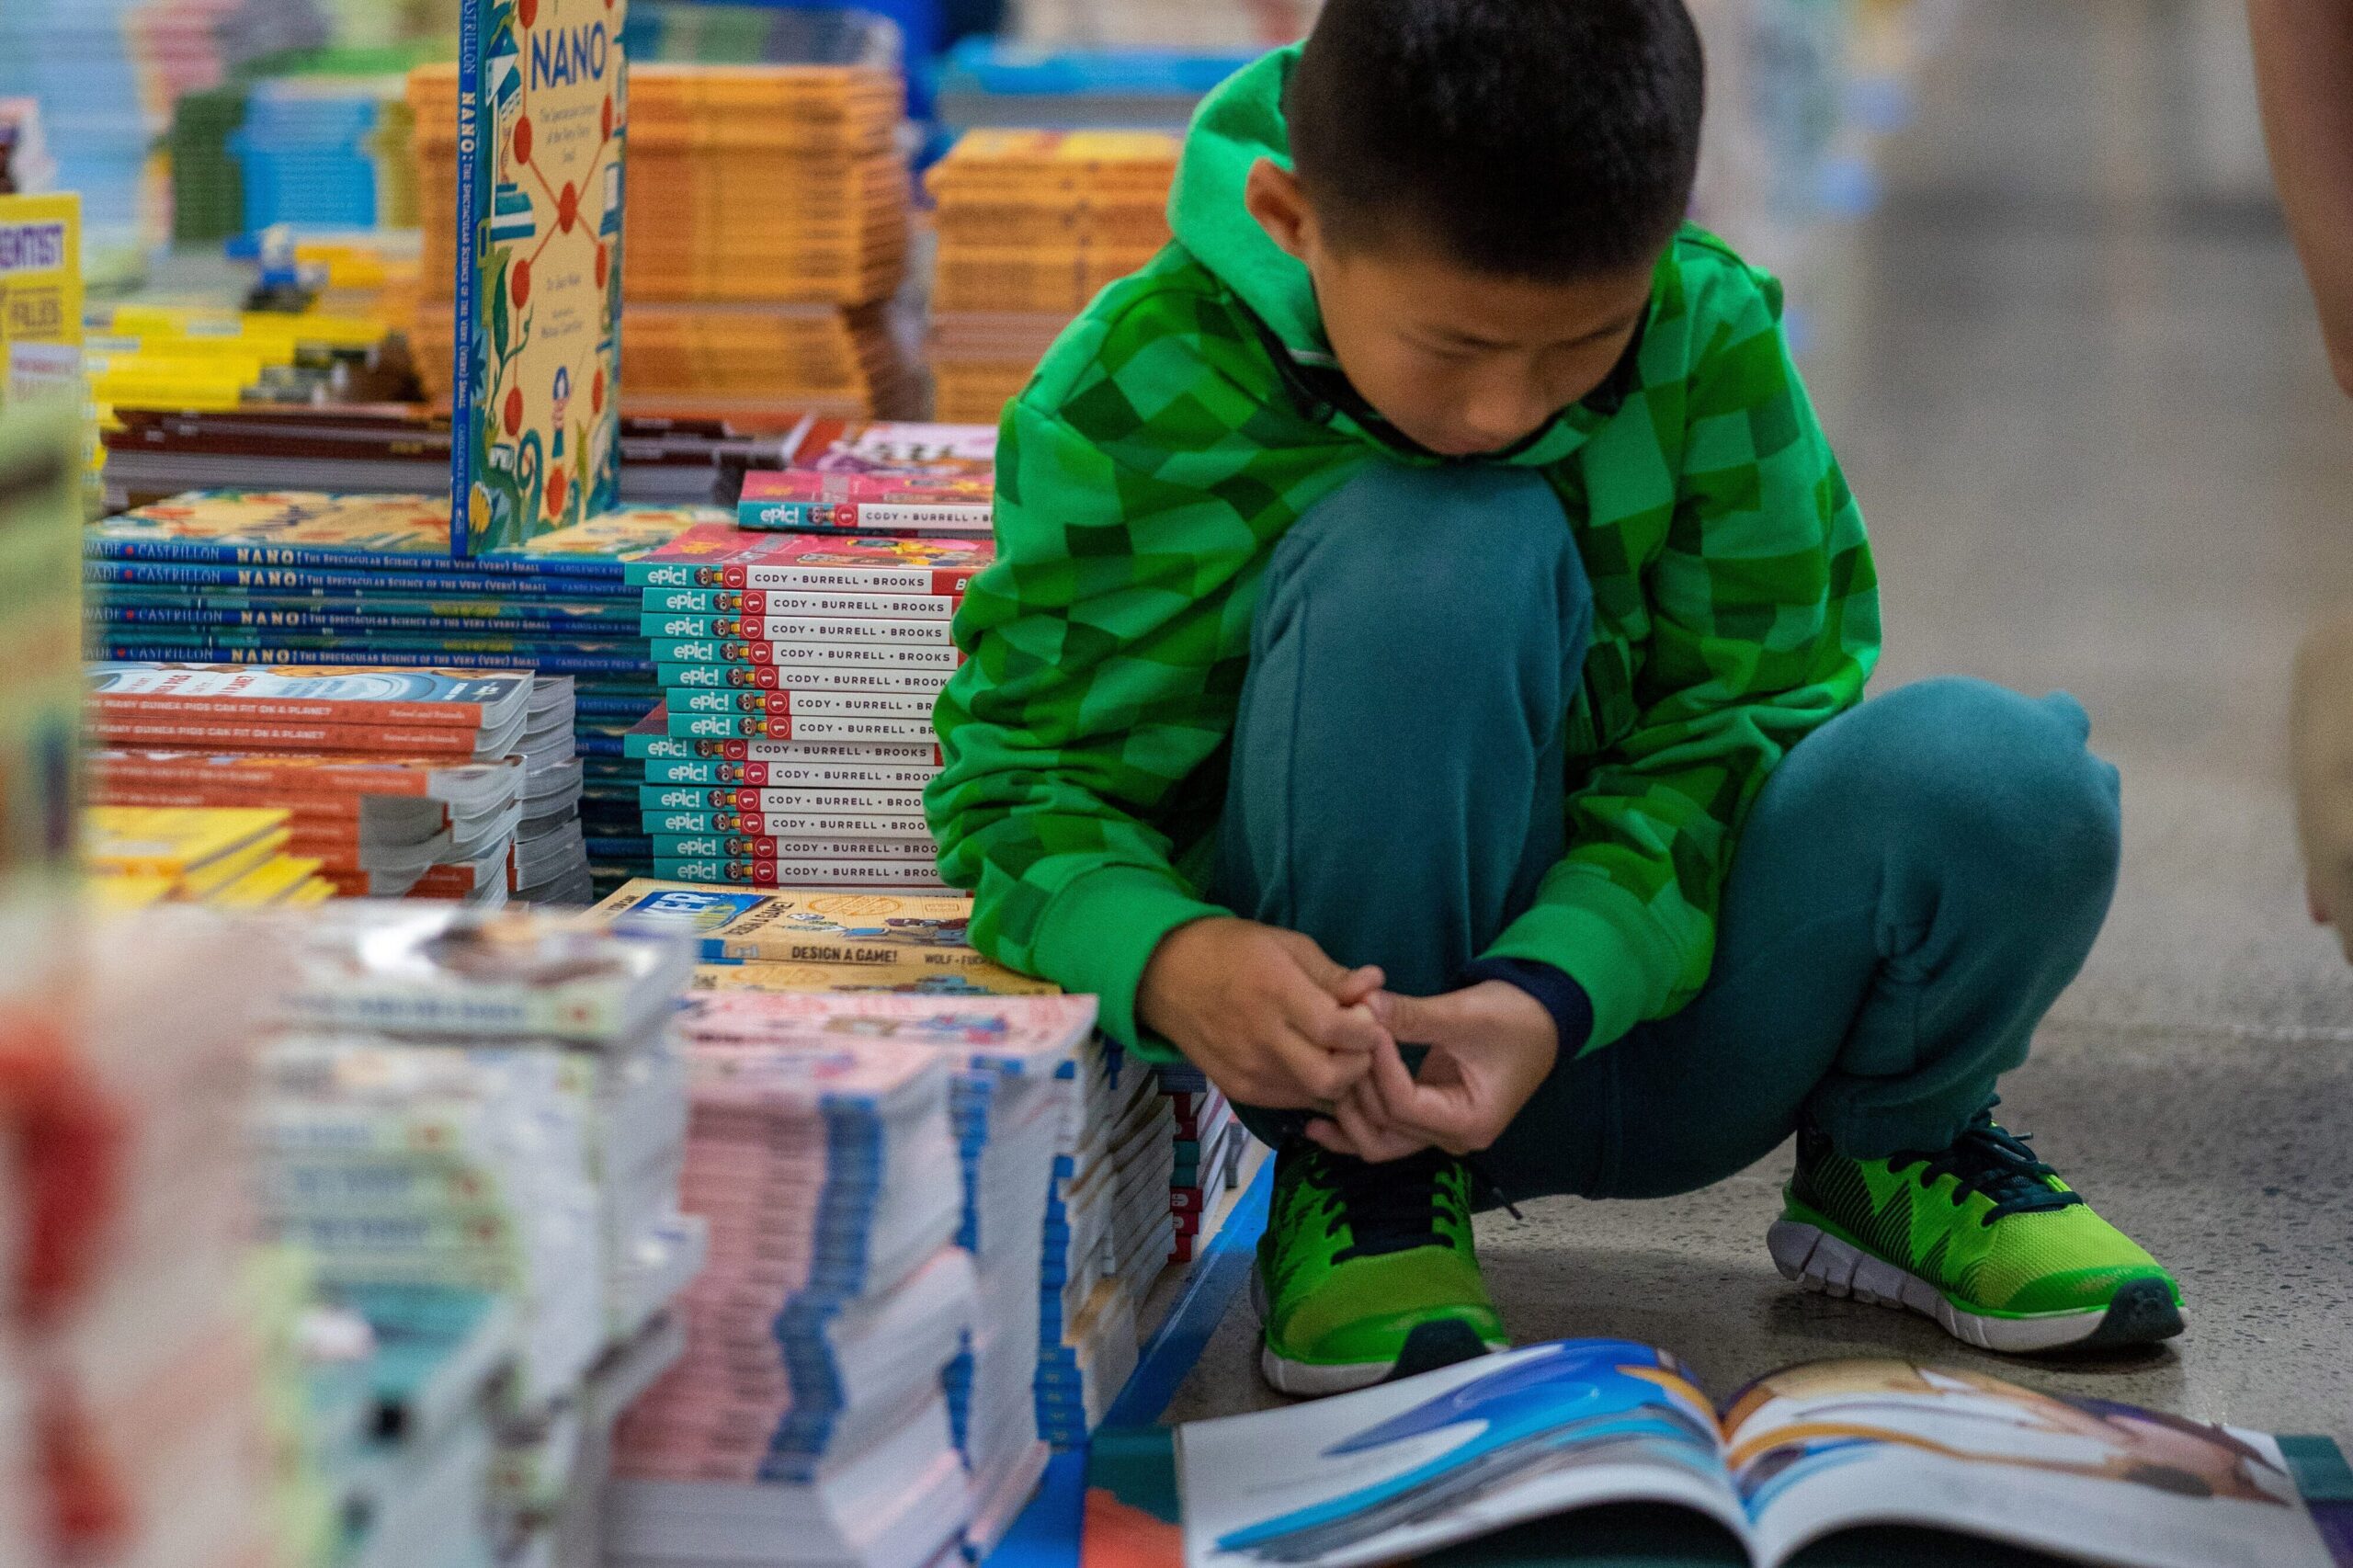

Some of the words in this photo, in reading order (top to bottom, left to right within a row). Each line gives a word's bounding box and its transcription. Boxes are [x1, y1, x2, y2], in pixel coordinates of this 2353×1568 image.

[463, 0, 476, 74] ASTRILLON
[531, 20, 607, 90] NANO
[460, 92, 476, 161] NANO:
[760, 504, 800, 525] epic!
[866, 512, 899, 521] CODY
[913, 513, 968, 522] BURRELL
[138, 544, 220, 560] CASTRILLON
[237, 548, 301, 564] NANO:
[138, 568, 221, 584] CASTRILLON
[238, 570, 304, 586] NANO:
[647, 565, 688, 585] epic!
[755, 574, 789, 583] CODY
[801, 574, 859, 585] BURRELL
[872, 577, 925, 586] BROOKS
[666, 590, 706, 611] epic!
[773, 599, 807, 608] CODY
[822, 600, 879, 610] BURRELL
[892, 602, 944, 612] BROOKS
[139, 609, 222, 623] CASTRILLON
[241, 610, 307, 626] NANO:
[665, 616, 704, 637] epic!
[771, 625, 805, 634] CODY
[819, 626, 877, 636] BURRELL
[891, 628, 942, 638] BROOKS
[130, 646, 213, 660] CASTRILLON
[231, 648, 297, 664] NANO:
[673, 641, 713, 661] epic!
[780, 649, 813, 658] CODY
[828, 650, 885, 660] BURRELL
[899, 652, 950, 662] BROOKS
[679, 665, 719, 687] epic!
[786, 674, 820, 683] CODY
[834, 676, 891, 686] BURRELL
[904, 677, 947, 687] BROOK
[689, 691, 729, 711] epic!
[797, 699, 831, 708] CODY
[845, 700, 903, 710] BURRELL
[690, 713, 731, 736] epic!
[799, 723, 833, 733] CODY
[847, 724, 905, 734] BURRELL
[647, 737, 688, 757] epic!
[756, 744, 790, 754] CODY
[803, 745, 861, 756] BURRELL
[874, 747, 926, 757] BROOKS
[667, 762, 708, 782] epic!
[776, 769, 810, 778] CODY
[824, 771, 881, 780] BURRELL
[895, 772, 930, 781] BROO
[661, 789, 700, 808] epic!
[767, 796, 801, 804] CODY
[815, 797, 873, 806] BURRELL
[887, 798, 922, 807] BROO
[665, 812, 704, 832] epic!
[772, 819, 806, 828] CODY
[820, 820, 877, 830] BURRELL
[891, 822, 926, 831] BROO
[676, 836, 717, 856] epic!
[784, 844, 818, 852] CODY
[833, 844, 891, 853] BURRELL
[904, 845, 938, 854] BROO
[676, 859, 717, 880] epic!
[784, 867, 819, 876] CODY
[833, 868, 890, 877] BURRELL
[904, 869, 938, 877] BROO
[791, 946, 840, 960] DESIGN
[843, 948, 853, 960] A
[856, 949, 898, 964] GAME!
